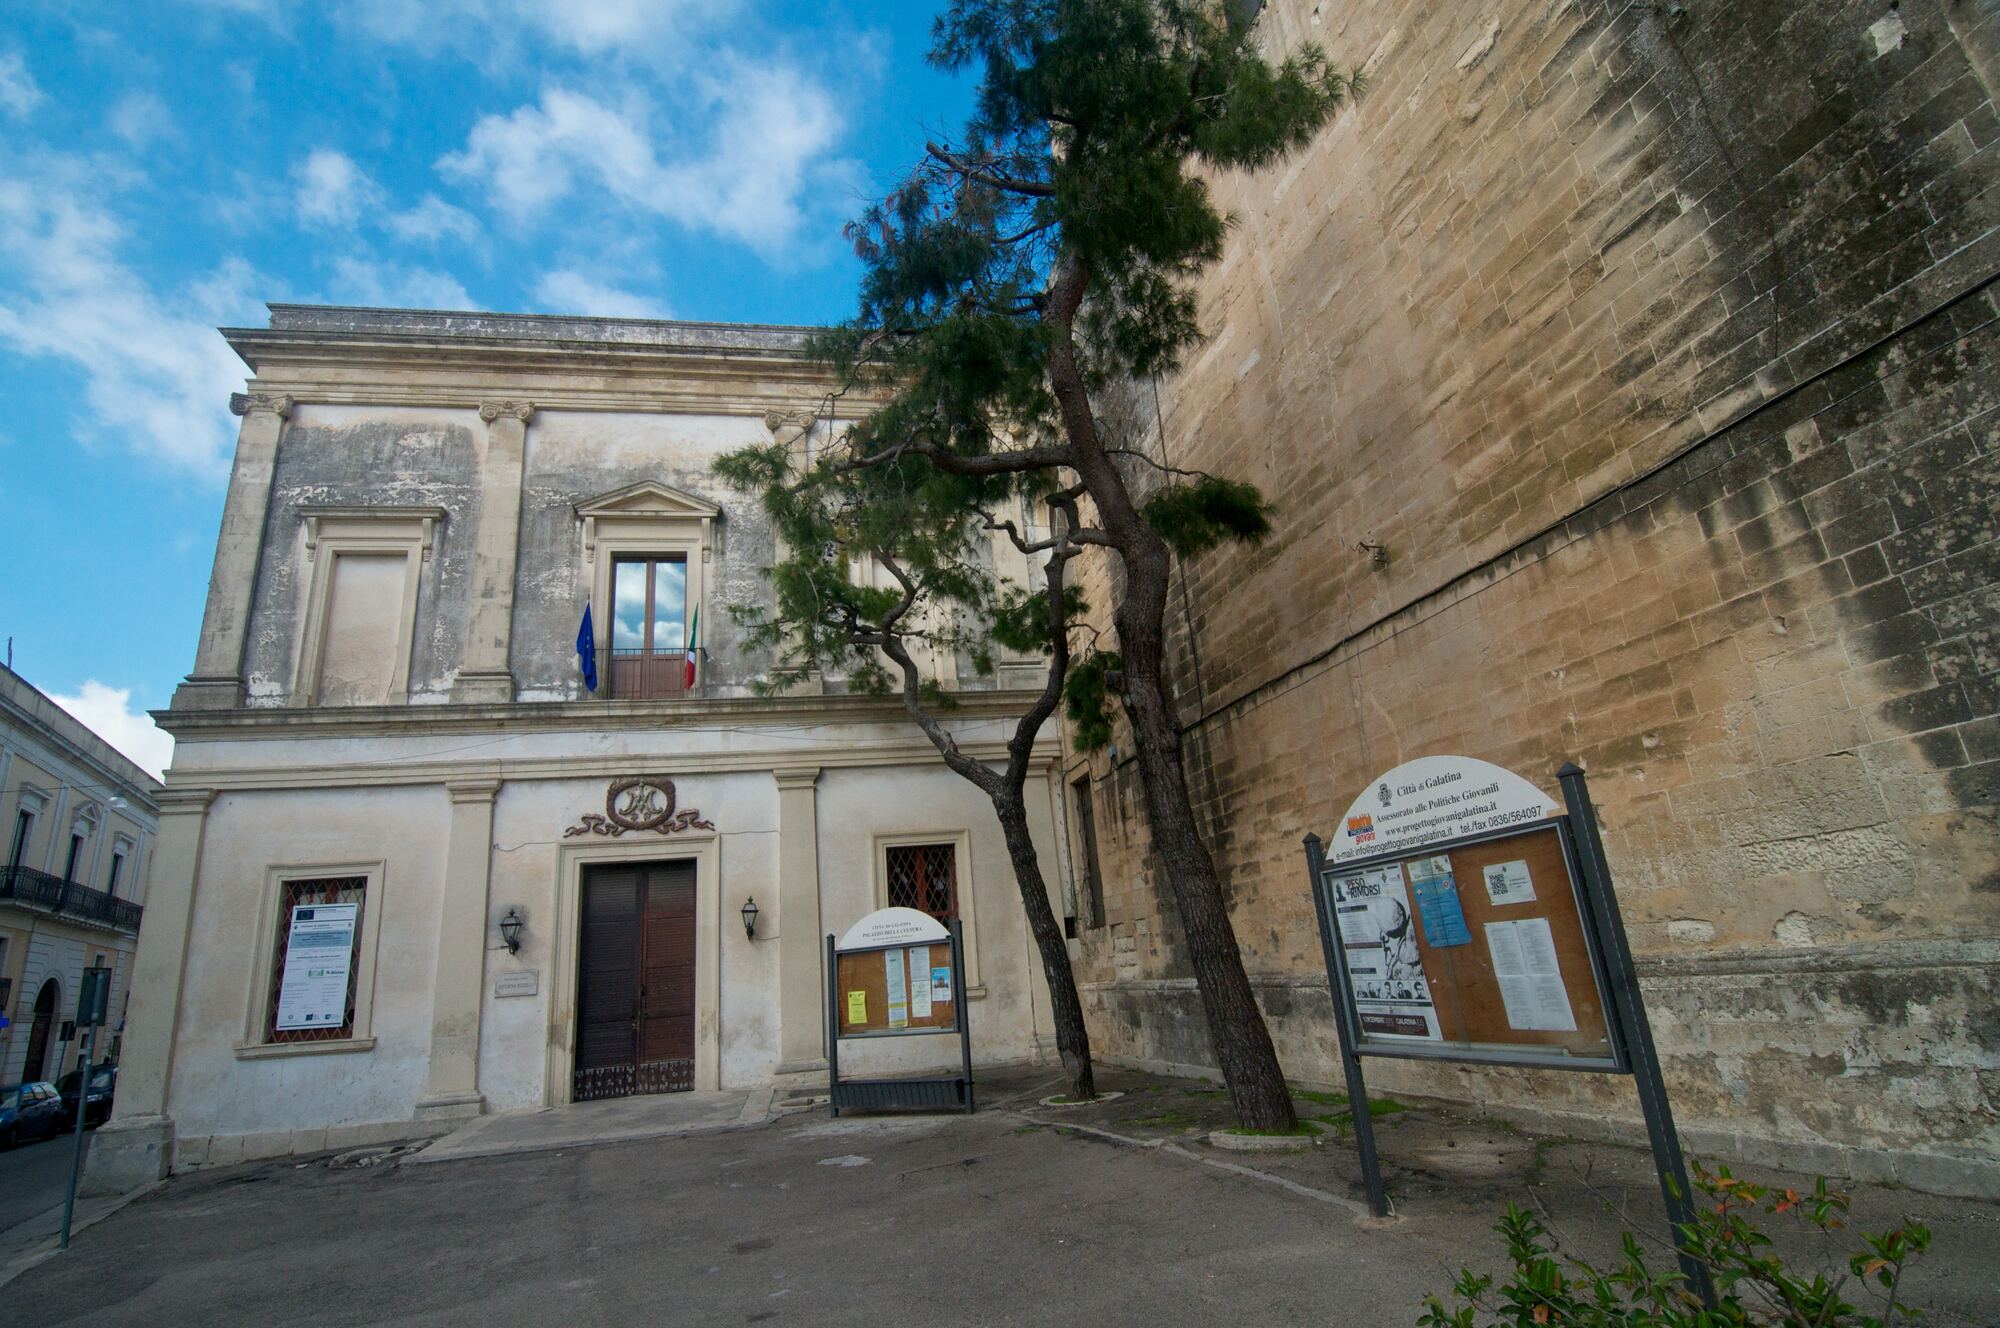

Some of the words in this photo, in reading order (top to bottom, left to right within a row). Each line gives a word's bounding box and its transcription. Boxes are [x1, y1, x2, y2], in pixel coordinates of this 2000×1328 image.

[1396, 783, 1417, 797] Città
[1418, 783, 1425, 791] di
[1425, 772, 1462, 788] Galatina
[1376, 807, 1414, 823] Assessorato
[1414, 803, 1428, 814] alle
[1428, 792, 1461, 809] Politiche
[1462, 782, 1500, 801] Giovanili
[1385, 802, 1497, 836] www.progettogiovanigalatina.it
[1488, 806, 1542, 828] 0836/564097
[1356, 832, 1376, 845] giovani
